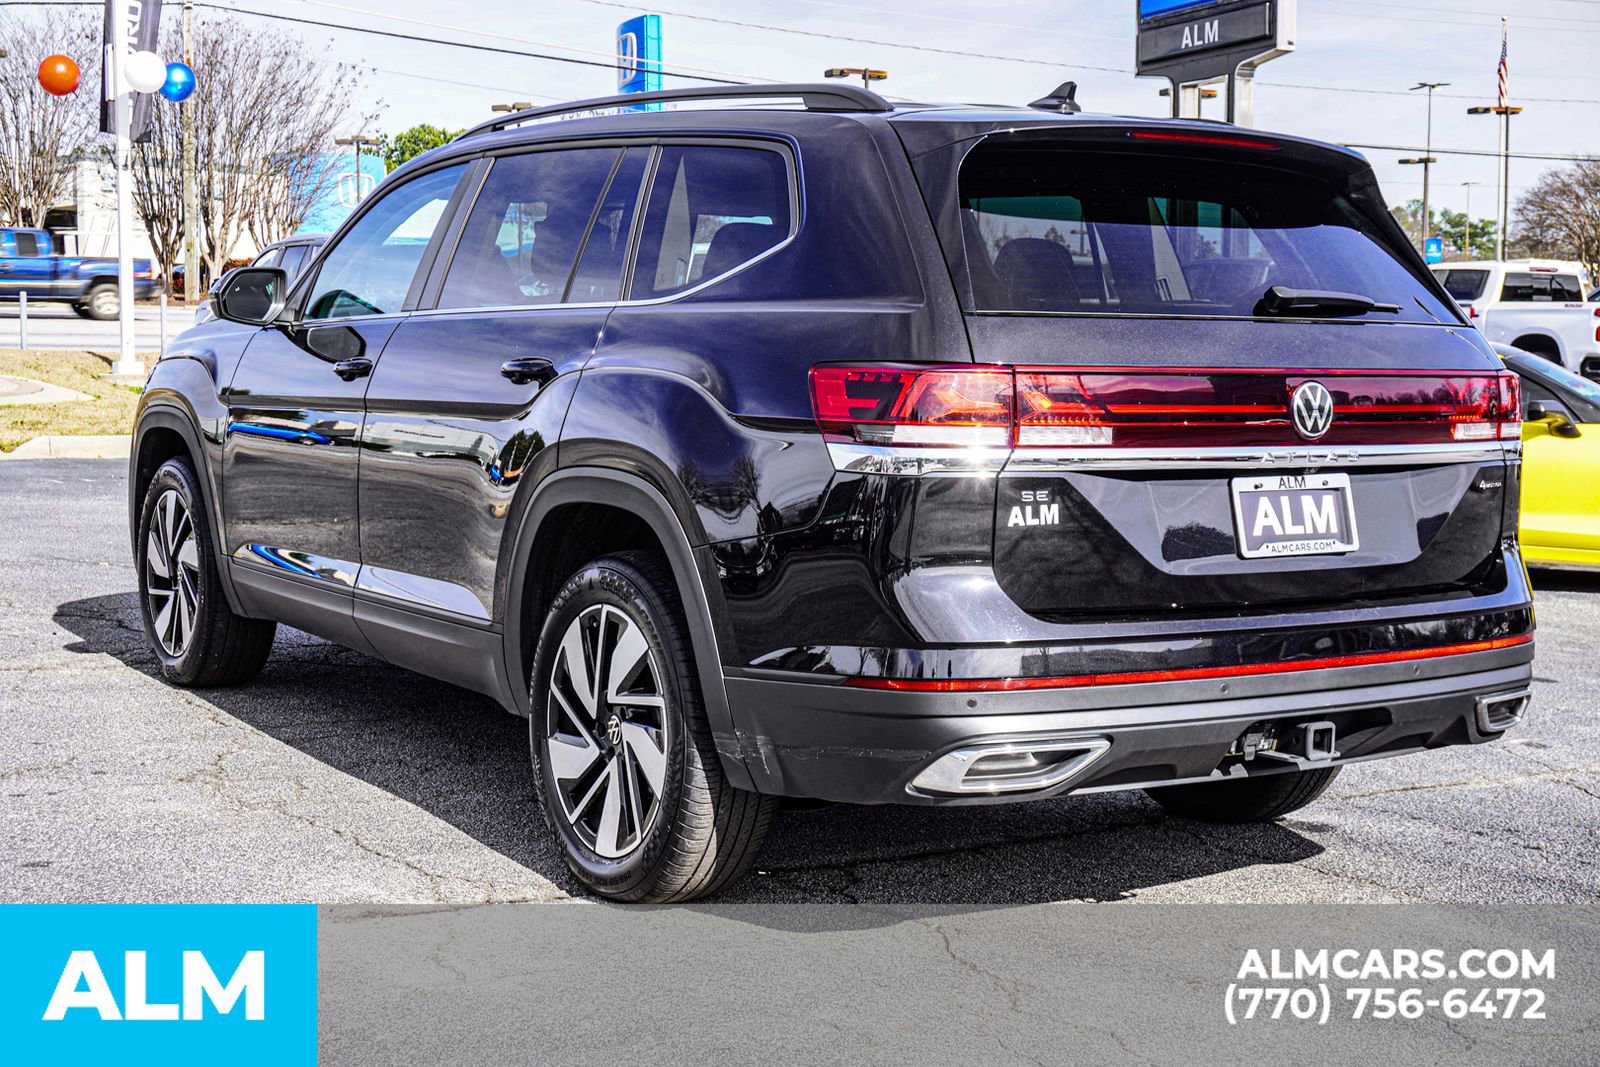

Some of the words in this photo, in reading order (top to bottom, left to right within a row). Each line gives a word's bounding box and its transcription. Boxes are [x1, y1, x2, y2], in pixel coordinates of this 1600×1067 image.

[1181, 19, 1219, 49] ALM
[1260, 451, 1359, 464] ATLAS
[1278, 475, 1307, 489] ALM
[1021, 490, 1049, 502] SE
[1007, 503, 1060, 527] ALM
[1253, 495, 1338, 536] ALM
[1271, 542, 1333, 553] ALMCARS.COM
